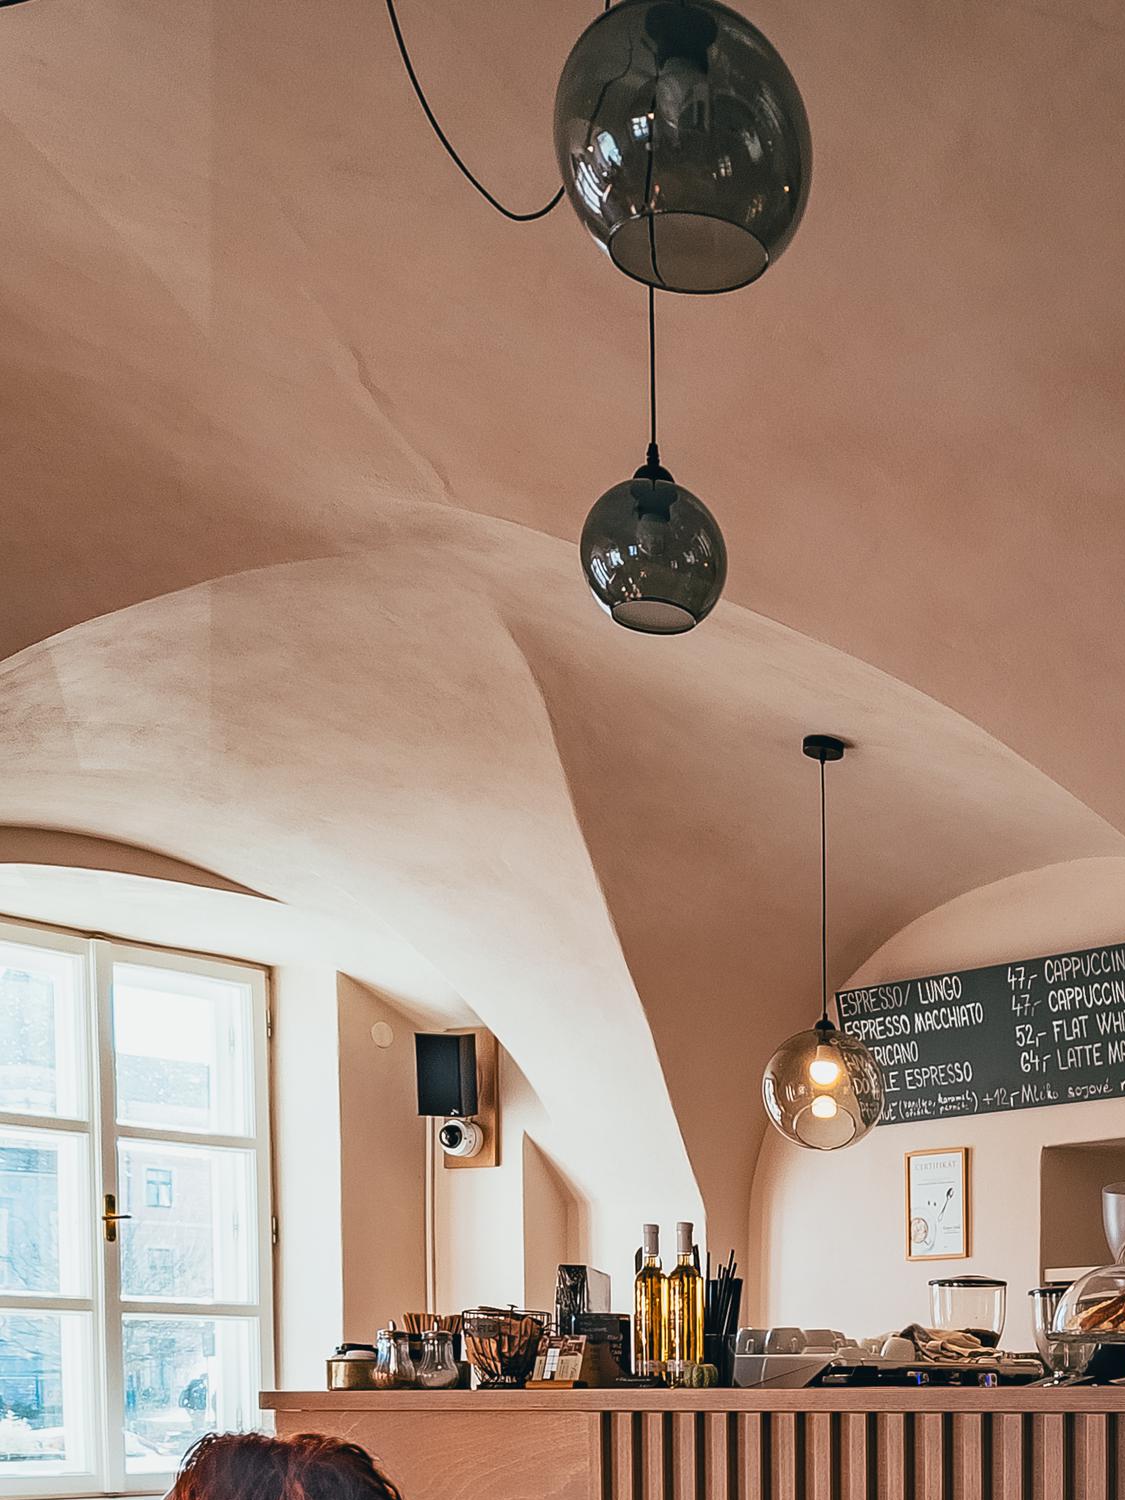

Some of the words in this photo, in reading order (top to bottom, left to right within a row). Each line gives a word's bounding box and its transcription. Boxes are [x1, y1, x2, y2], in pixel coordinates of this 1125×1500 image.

[918, 975, 962, 1005] LUNGO
[844, 1013, 911, 1042] ESPRESSO
[914, 1002, 984, 1034] MACCHIATO
[1052, 1014, 1089, 1043] FLAT
[905, 1061, 973, 1090] ESPRESSO
[1056, 1042, 1104, 1071] LATTE
